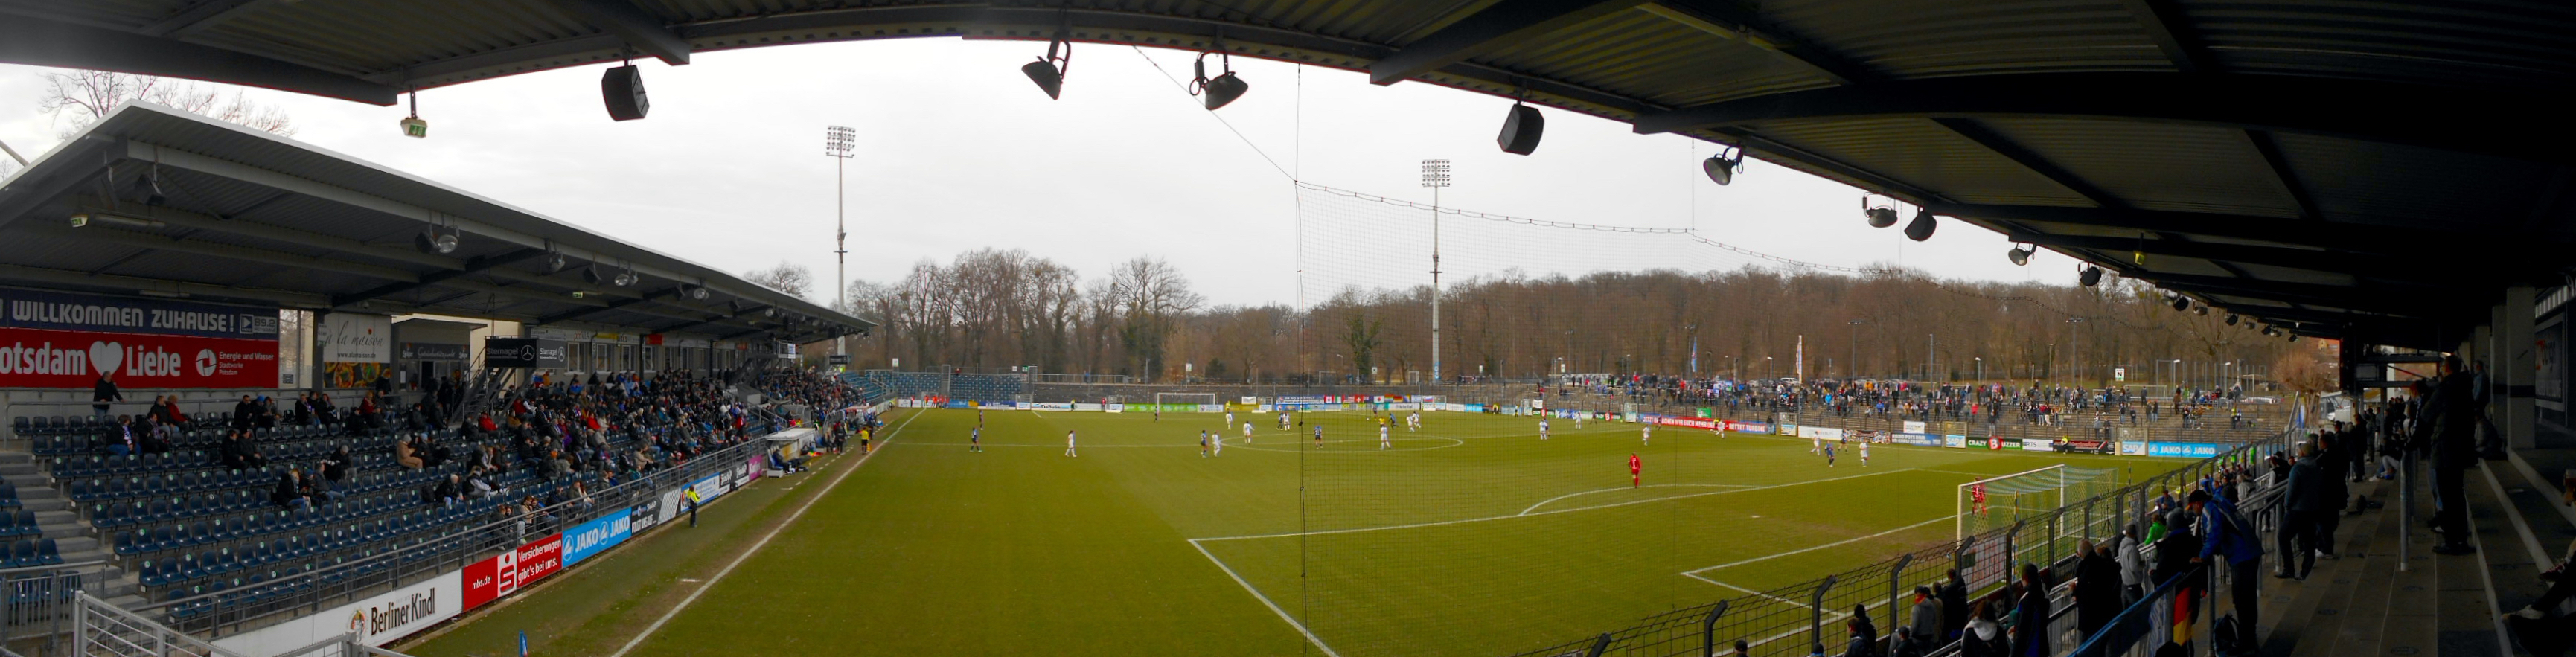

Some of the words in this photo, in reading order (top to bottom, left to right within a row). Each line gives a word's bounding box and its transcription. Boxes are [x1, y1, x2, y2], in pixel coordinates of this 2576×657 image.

[13, 300, 143, 327] WILLKOMMEN
[254, 318, 275, 327] 89.2
[0, 342, 86, 375] otsdam
[127, 345, 181, 376] Liebe
[219, 351, 242, 362] Energie
[254, 353, 274, 361] Wasser
[487, 347, 518, 356] Sternagel
[540, 347, 557, 356] Sternagel
[610, 515, 630, 538] JAKO
[517, 539, 562, 563] Versicherungen
[575, 528, 599, 553] JAKO
[517, 565, 534, 584] gibt's
[535, 561, 545, 574] bei
[545, 557, 558, 571] uns.
[472, 576, 490, 591] mbs.de
[371, 603, 410, 635] Berliner
[411, 587, 435, 622] Kindl
